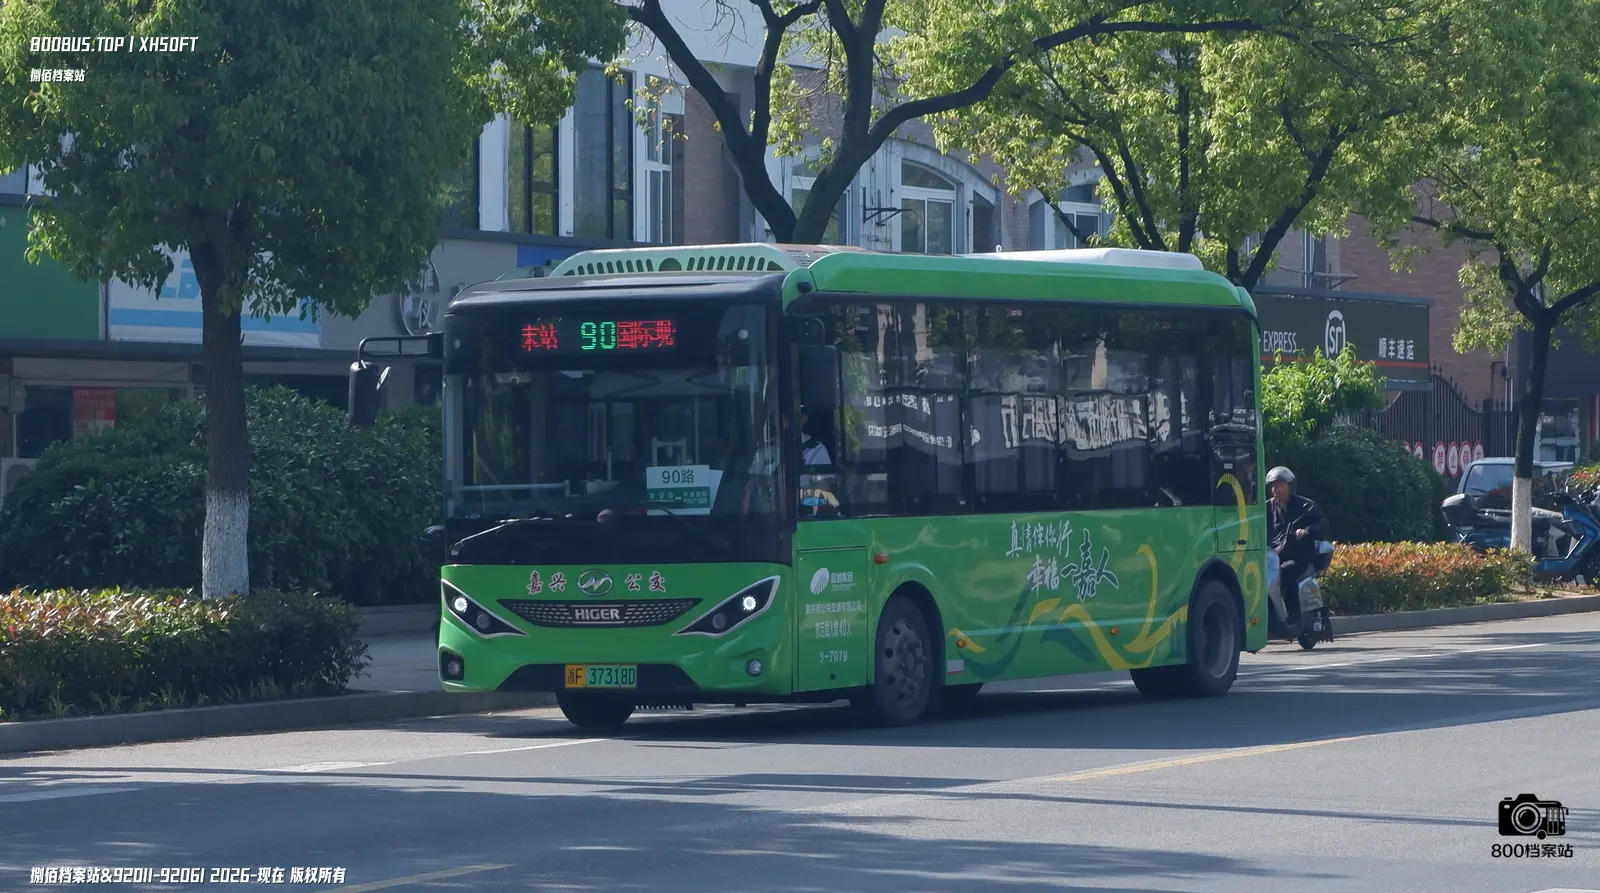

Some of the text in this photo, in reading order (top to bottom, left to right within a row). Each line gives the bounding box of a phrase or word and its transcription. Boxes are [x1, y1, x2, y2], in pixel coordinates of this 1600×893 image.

[580, 321, 616, 350] 90
[1263, 330, 1297, 353] EXPRESS
[1379, 337, 1414, 361] 顺丰速运
[662, 469, 695, 484] 90路
[1005, 519, 1073, 558] 真情伴你行
[1026, 528, 1120, 603] 幸福一嘉人
[527, 570, 667, 595] 嘉兴 公交
[575, 608, 621, 621] HIGER
[819, 650, 848, 663] 3-7079
[567, 668, 636, 686] 浙F 37318D
